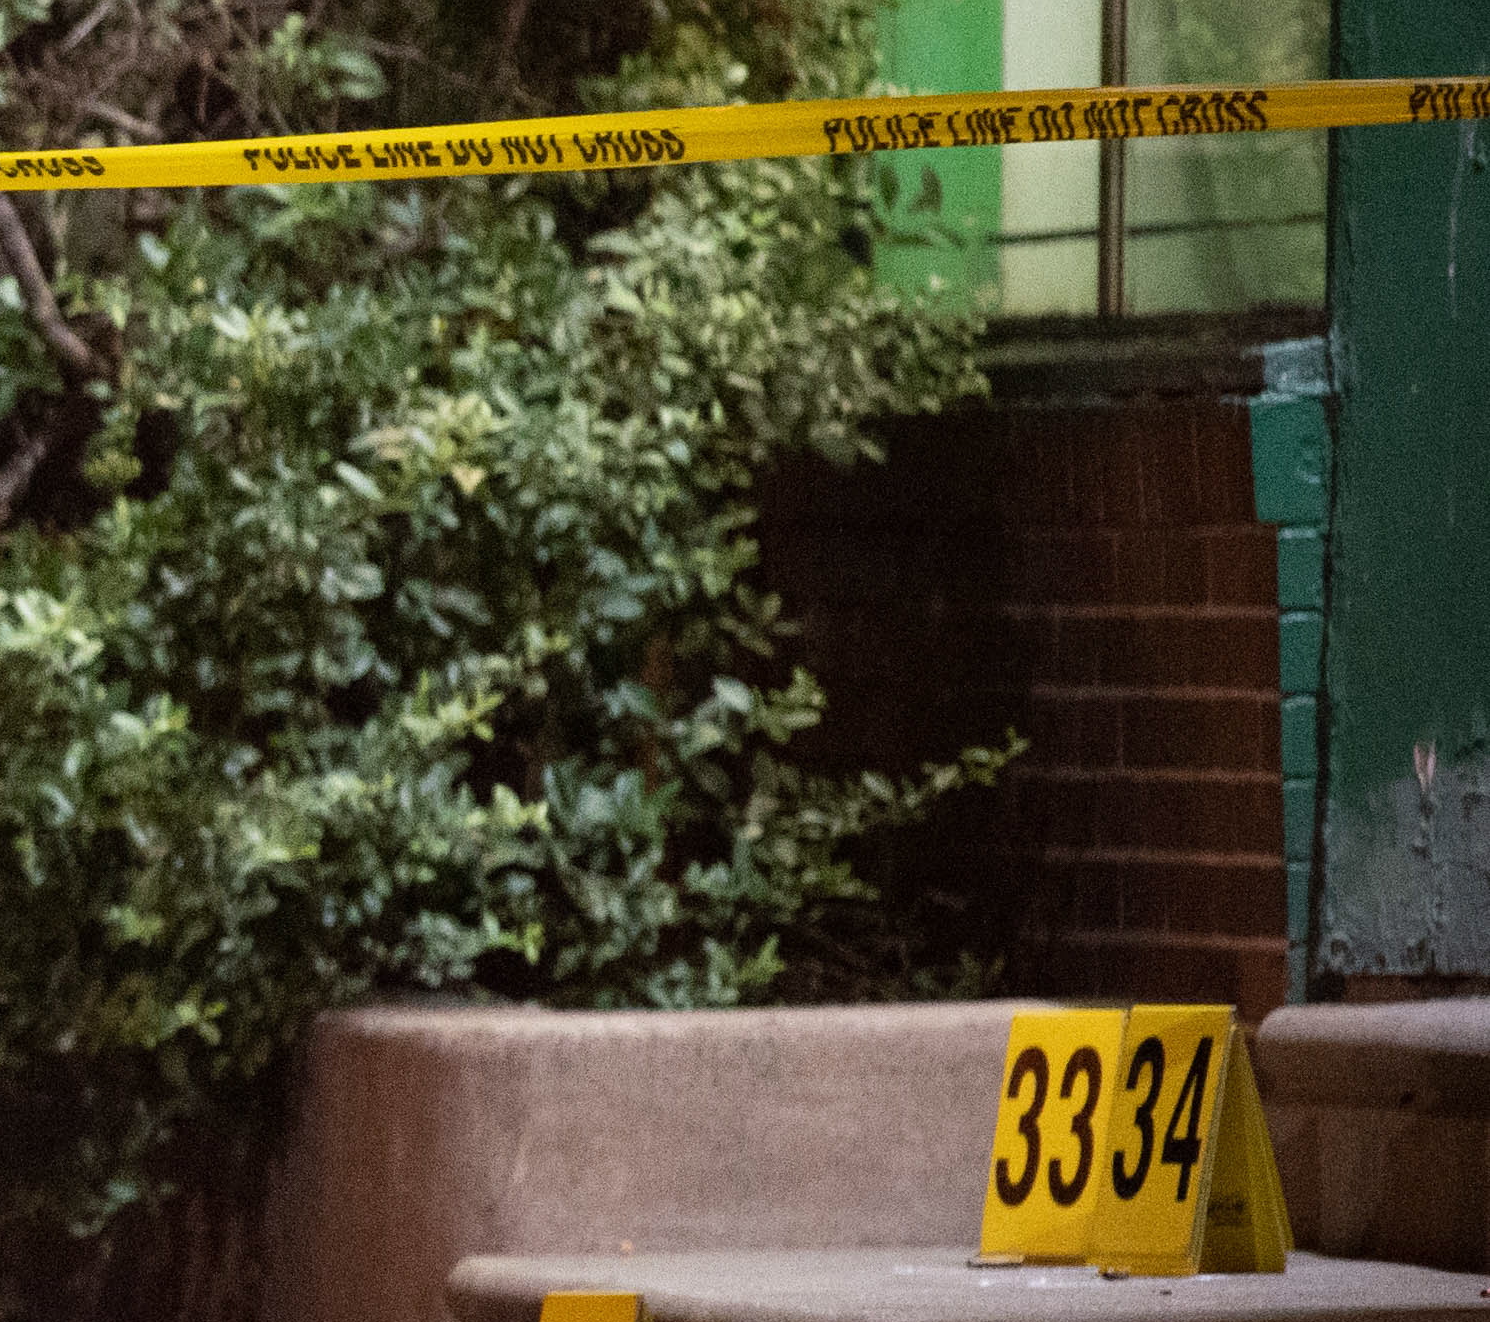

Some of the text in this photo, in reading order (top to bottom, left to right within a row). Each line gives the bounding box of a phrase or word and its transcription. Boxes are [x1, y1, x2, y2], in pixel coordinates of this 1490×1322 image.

[824, 91, 1269, 154] POLICE LINE DO NOT CROSS
[995, 1046, 1103, 1207] 33
[1112, 1036, 1214, 1202] 34
